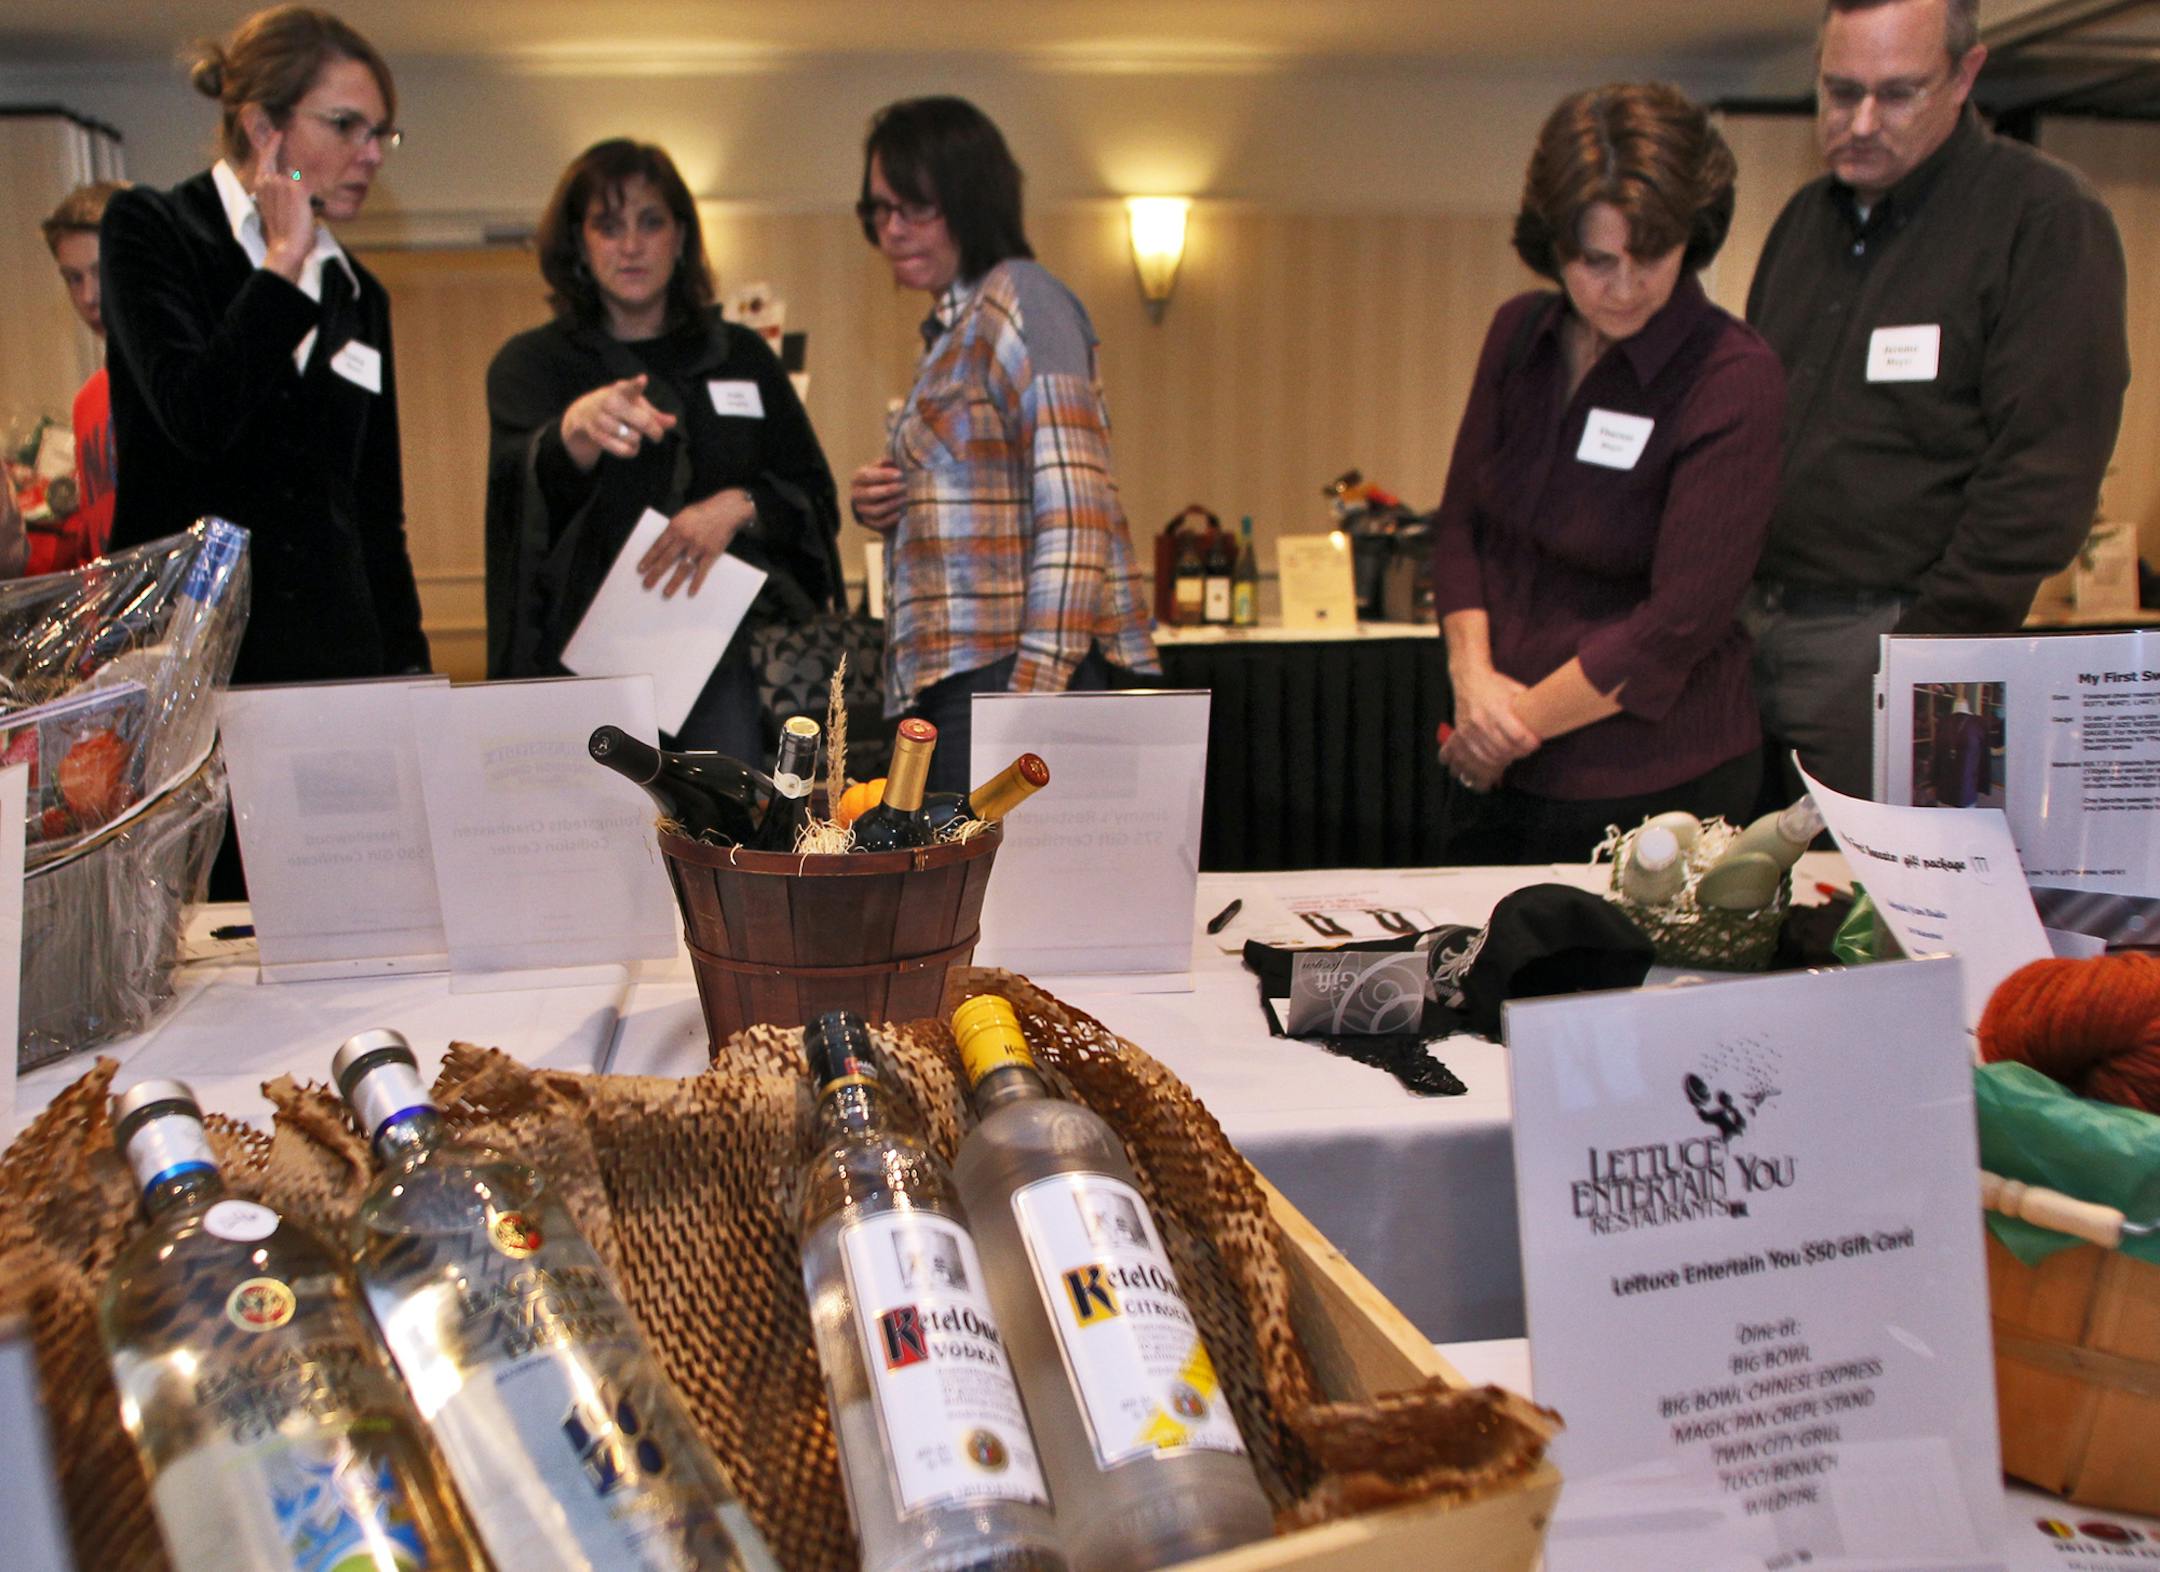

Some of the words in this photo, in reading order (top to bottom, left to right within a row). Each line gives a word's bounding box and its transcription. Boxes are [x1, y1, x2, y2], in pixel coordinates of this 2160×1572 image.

[2078, 673, 2100, 686] My
[2103, 671, 2139, 683] First
[1315, 971, 1358, 992] Gift
[1588, 1136, 1728, 1183] LETTUCE
[1571, 1165, 1728, 1219] ENTERTAIN
[1735, 1153, 1797, 1192] YOU
[1612, 1271, 1680, 1297] Lettuce
[1682, 1254, 1766, 1285] Entertain
[1765, 1248, 1801, 1270] You
[1803, 1240, 1837, 1266] $50
[1840, 1233, 1873, 1259] Gift
[1875, 1226, 1915, 1251] Card
[1737, 1322, 1775, 1344] Dine
[1731, 1353, 1761, 1375] BIG
[1764, 1345, 1813, 1369] BOWL
[1659, 1396, 1690, 1418] BIG
[1694, 1386, 1743, 1410] BOWL
[1748, 1371, 1814, 1400] CHINESE
[1818, 1358, 1884, 1387] EXPRESS
[1671, 1417, 1730, 1444] MAGIC
[1735, 1410, 1768, 1433] PAN
[1824, 1387, 1876, 1414] STAND
